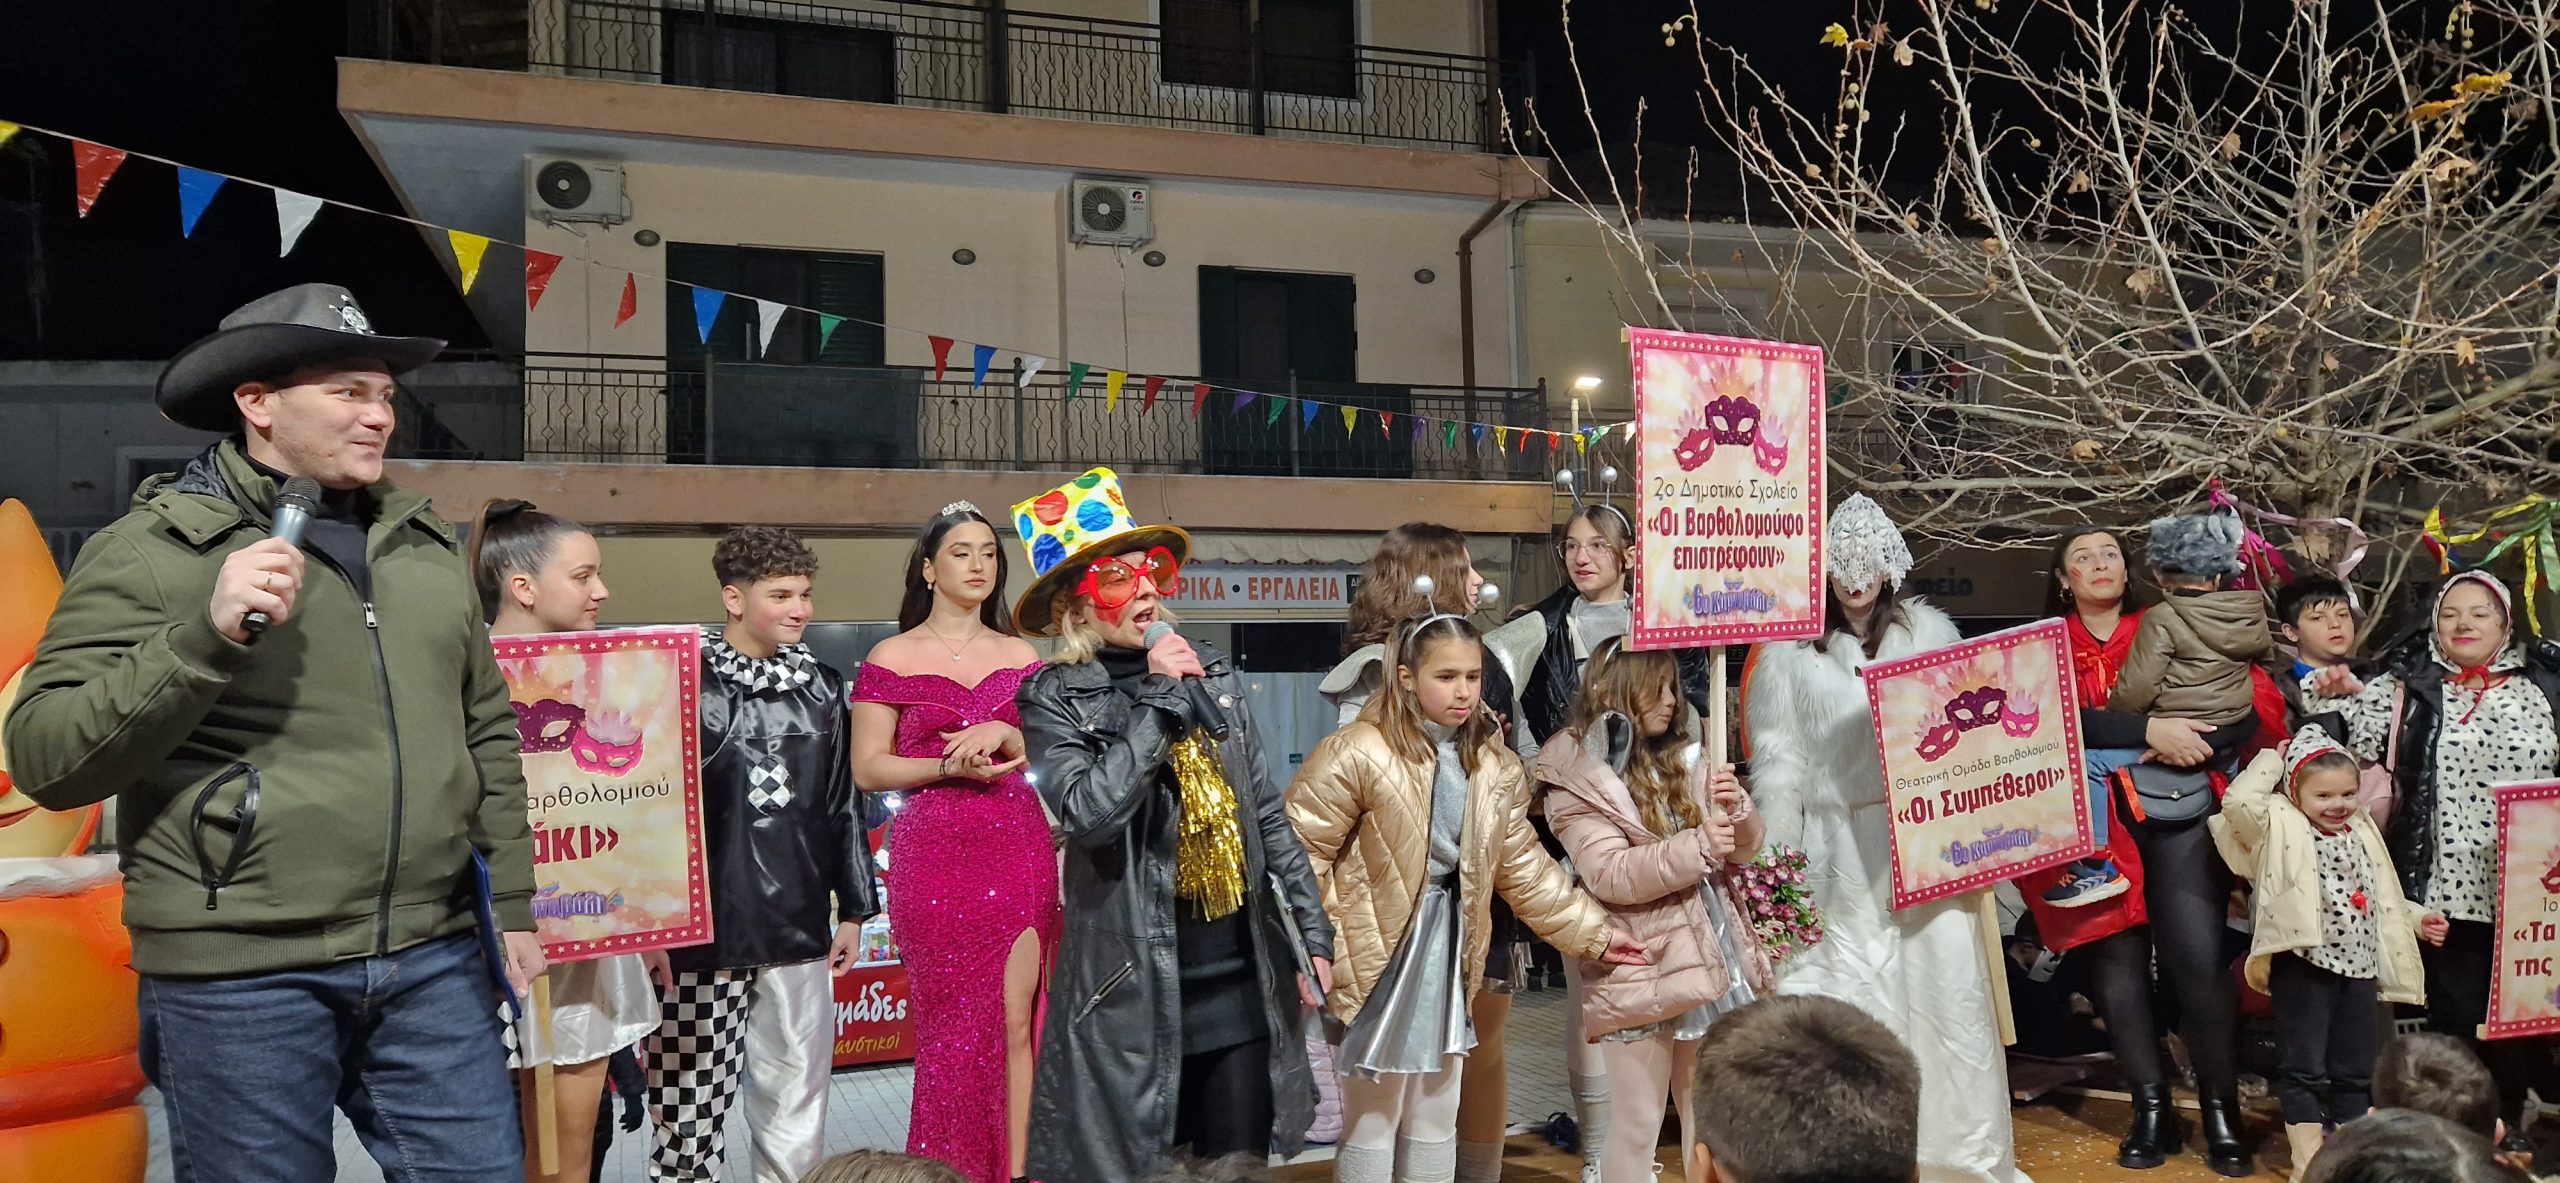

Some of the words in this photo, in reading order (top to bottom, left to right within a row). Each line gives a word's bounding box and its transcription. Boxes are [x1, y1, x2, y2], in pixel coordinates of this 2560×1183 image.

[1680, 477, 1744, 503] Δημοτικό
[1749, 479, 1798, 504] Σχολείο
[1647, 506, 1679, 536] «Οι
[1685, 505, 1804, 539] Βαρθολομούφο
[1674, 541, 1785, 572] επιστρέφουν»
[1161, 577, 1225, 600] ΡΙΚΑ
[1248, 577, 1340, 600] ΕΡΓΑΛΕΙΑ
[1896, 770, 1949, 790] Θεατρική
[1952, 759, 1991, 777] Ομάδα
[1994, 738, 2059, 766] Βαρθολομιού
[527, 777, 669, 814] αρθολομιού
[1898, 796, 1935, 824] «Οι
[1940, 767, 2065, 817] Συμπέθεροι»
[533, 821, 619, 865] άκι»
[2513, 921, 2556, 943] «Τα
[2515, 956, 2554, 977] της
[834, 1032, 900, 1055] αυστικοί
